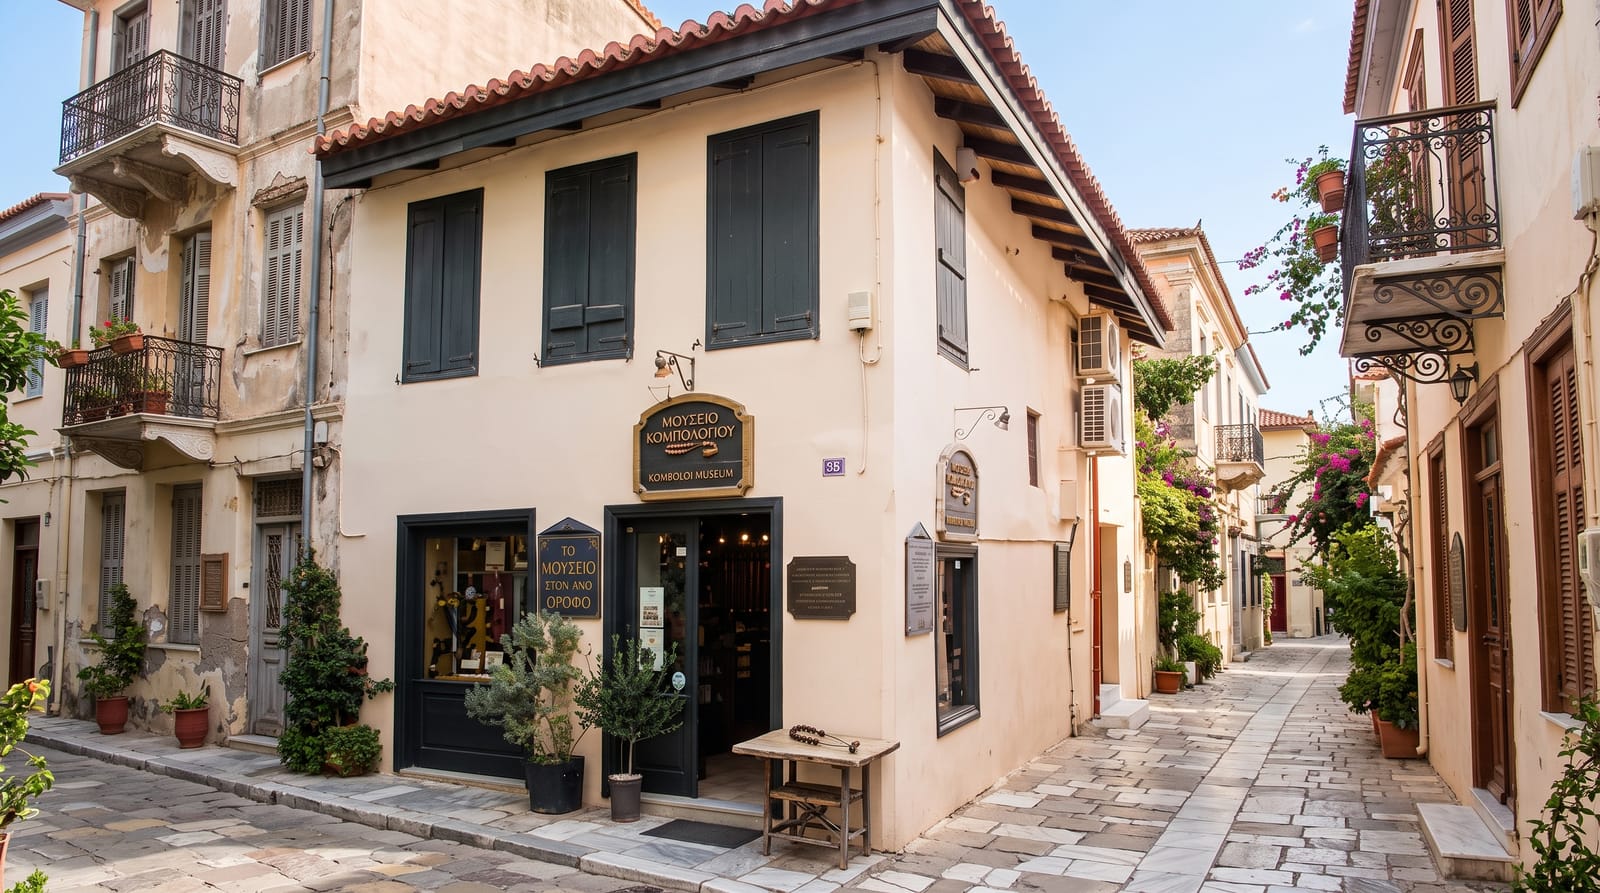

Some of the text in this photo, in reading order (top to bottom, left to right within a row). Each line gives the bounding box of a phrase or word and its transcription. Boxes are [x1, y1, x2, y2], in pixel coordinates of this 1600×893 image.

[662, 412, 718, 428] ΜΟΥΣΕΙΟ
[648, 469, 733, 483] KOMBOLOI MUSEUM
[561, 545, 576, 556] ΤΟ
[542, 560, 596, 575] ΜΟΥΣΕΙΟ
[545, 580, 593, 592] ΣΤΟΝ ΑΝΟ
[546, 595, 591, 609] ΟΡΟΦΟ
